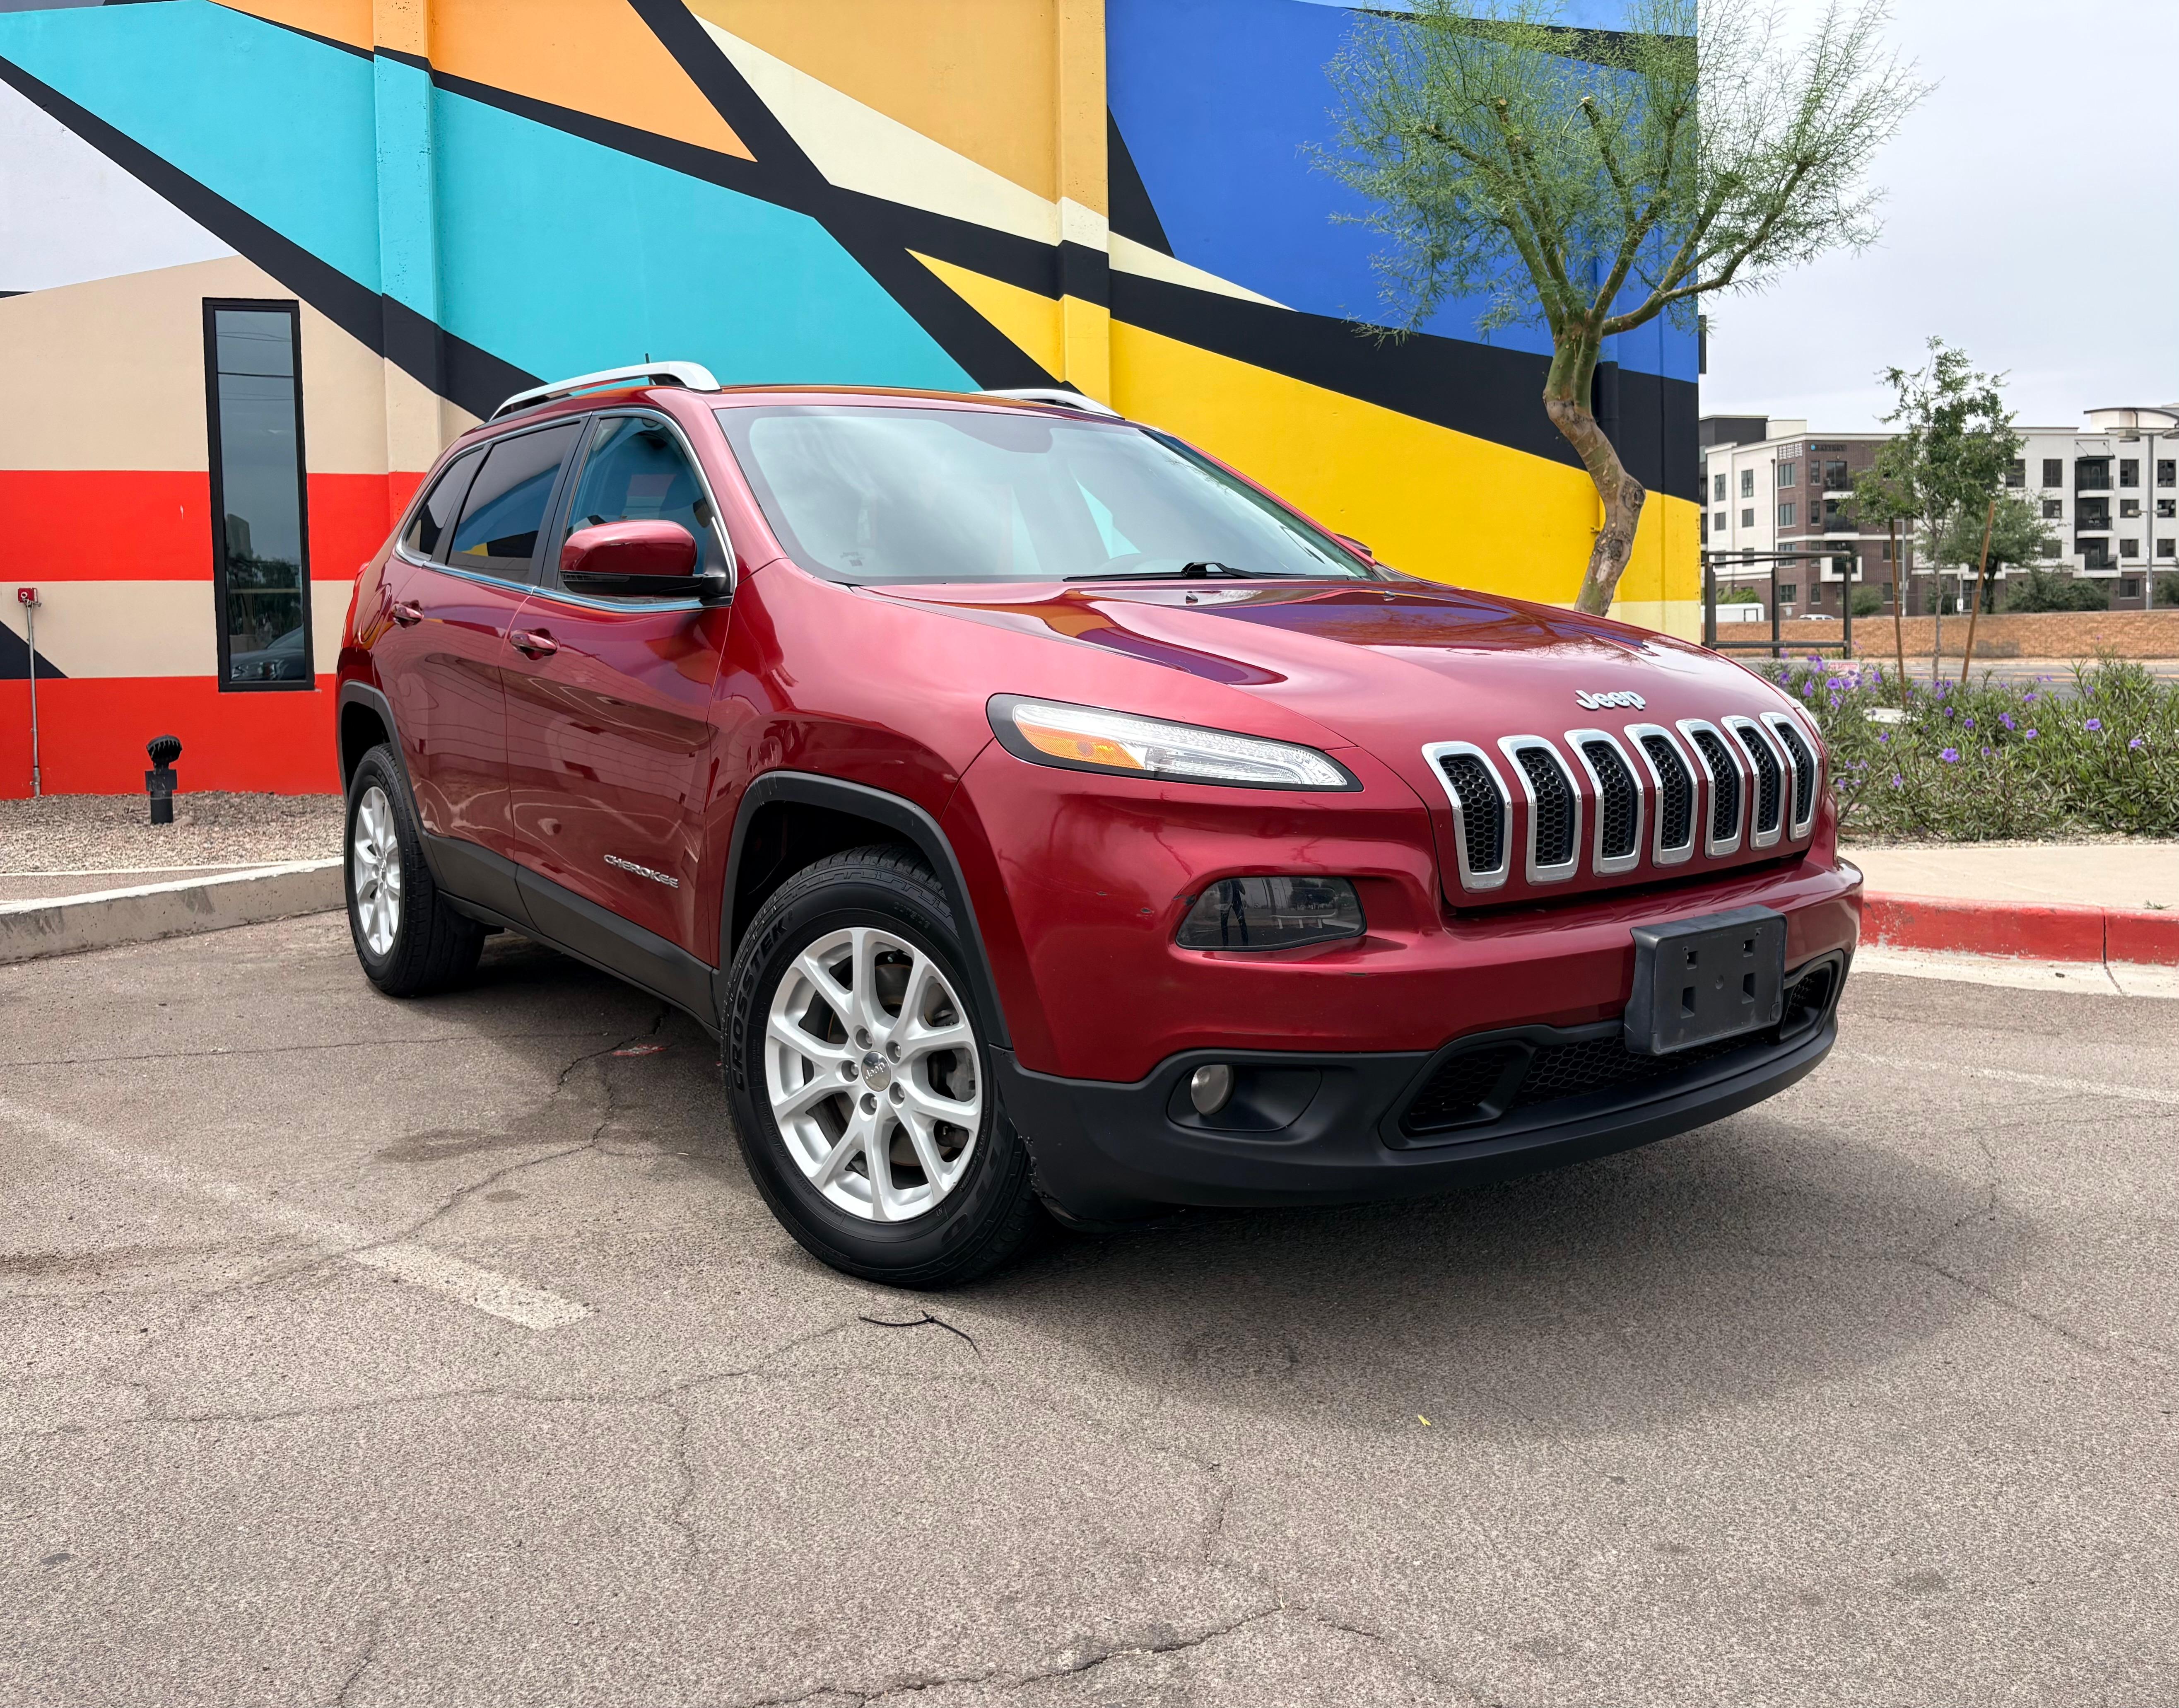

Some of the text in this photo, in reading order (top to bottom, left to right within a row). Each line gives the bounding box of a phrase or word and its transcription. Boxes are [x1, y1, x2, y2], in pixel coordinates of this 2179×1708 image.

[1575, 690, 1646, 710] Jeep
[604, 854, 679, 888] CHEROKEE
[865, 1062, 885, 1079] Jeep
